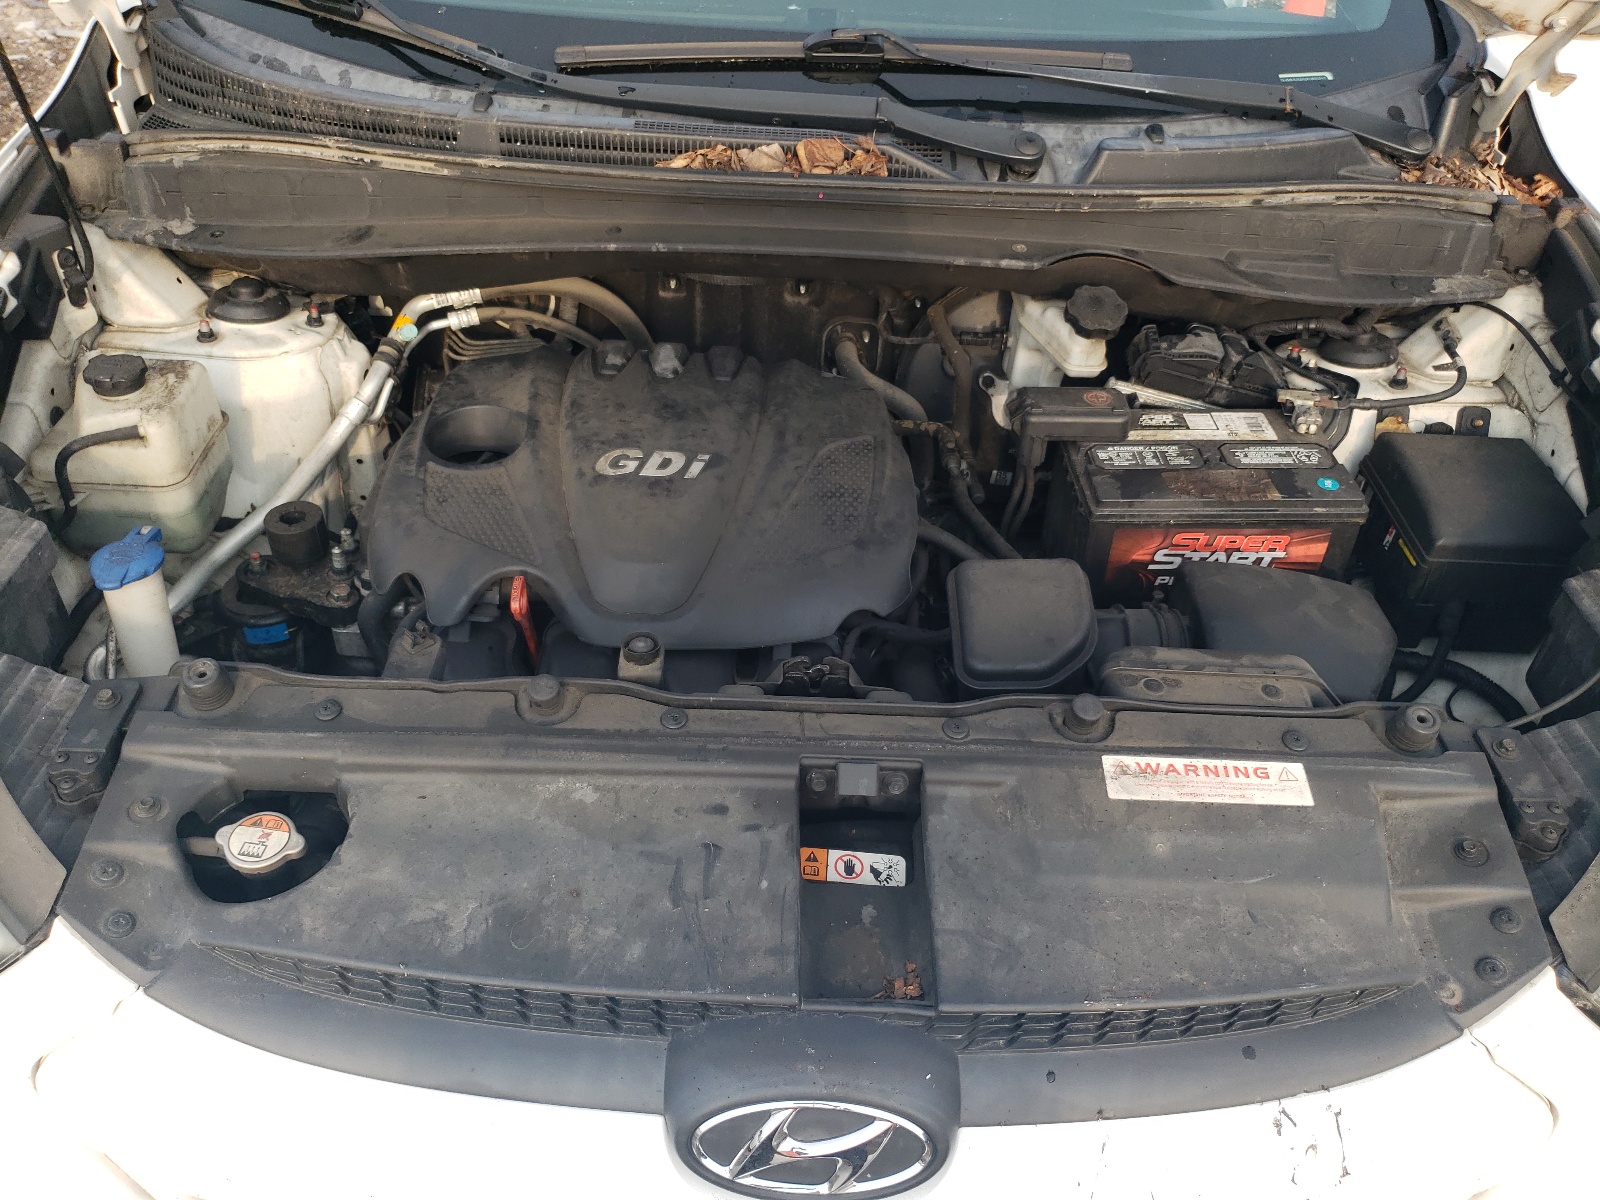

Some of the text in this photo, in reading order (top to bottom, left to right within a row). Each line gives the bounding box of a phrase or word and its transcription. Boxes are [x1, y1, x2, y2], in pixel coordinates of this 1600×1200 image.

[595, 447, 712, 479] GDi
[1168, 532, 1291, 552] SUPER
[1135, 762, 1270, 779] WARNING
